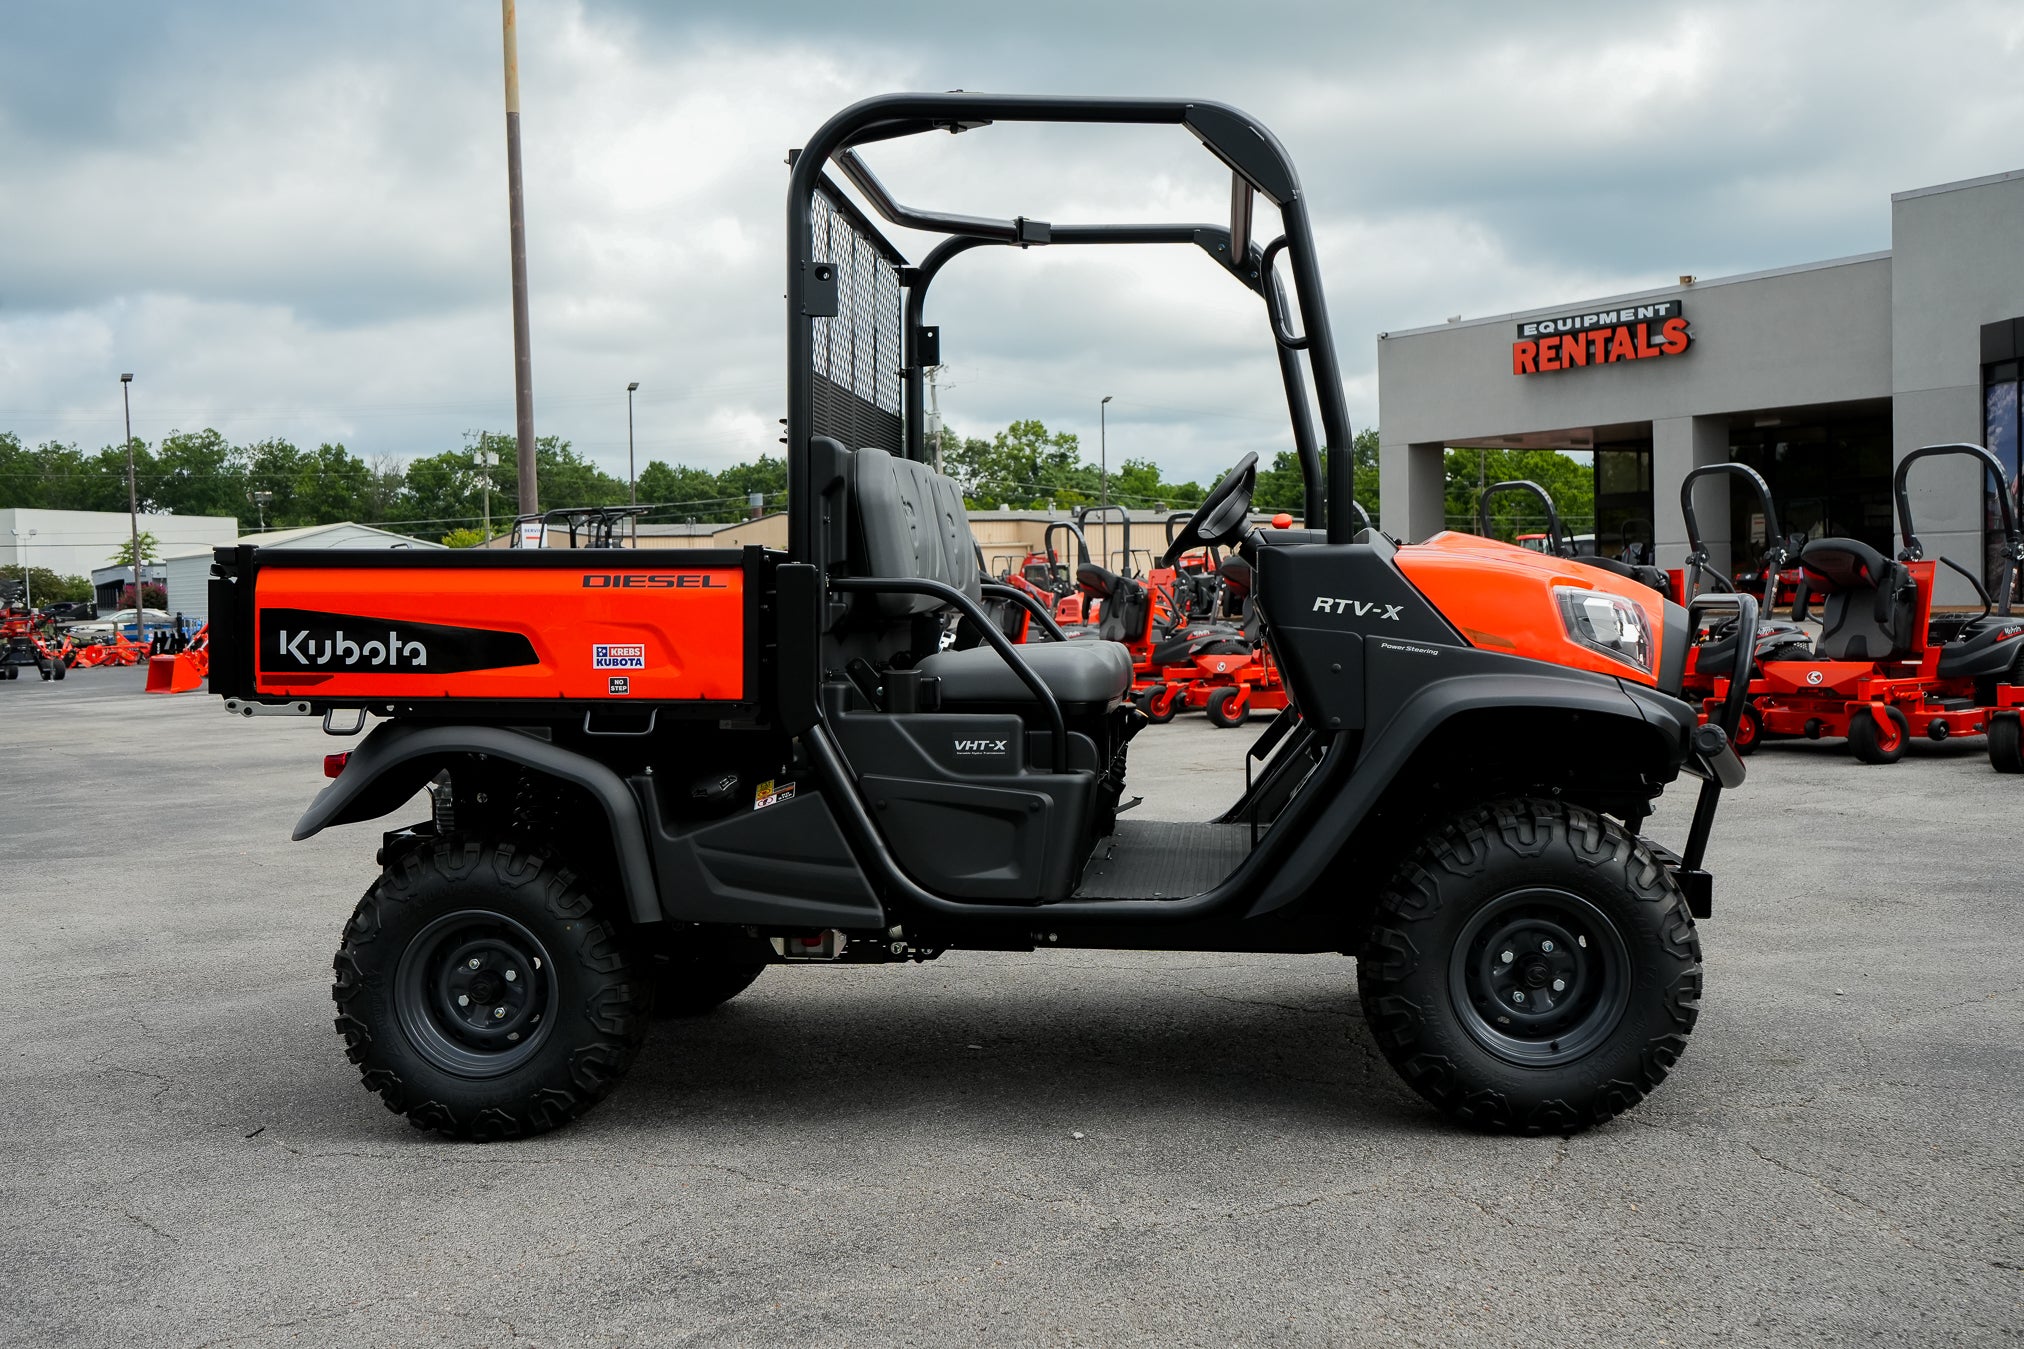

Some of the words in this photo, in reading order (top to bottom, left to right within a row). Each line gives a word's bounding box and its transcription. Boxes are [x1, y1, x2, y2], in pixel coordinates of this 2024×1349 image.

[1523, 303, 1670, 336] EQUIPMENT
[1513, 317, 1689, 375] RENTALS
[582, 574, 727, 588] DIESEL
[1312, 596, 1404, 621] RTV-X
[279, 630, 427, 666] Kubota
[610, 648, 641, 656] KREBS
[1381, 642, 1405, 651] Power
[1405, 645, 1439, 656] Steering
[596, 658, 643, 667] KUBOTA
[954, 740, 1008, 751] VHT-X
